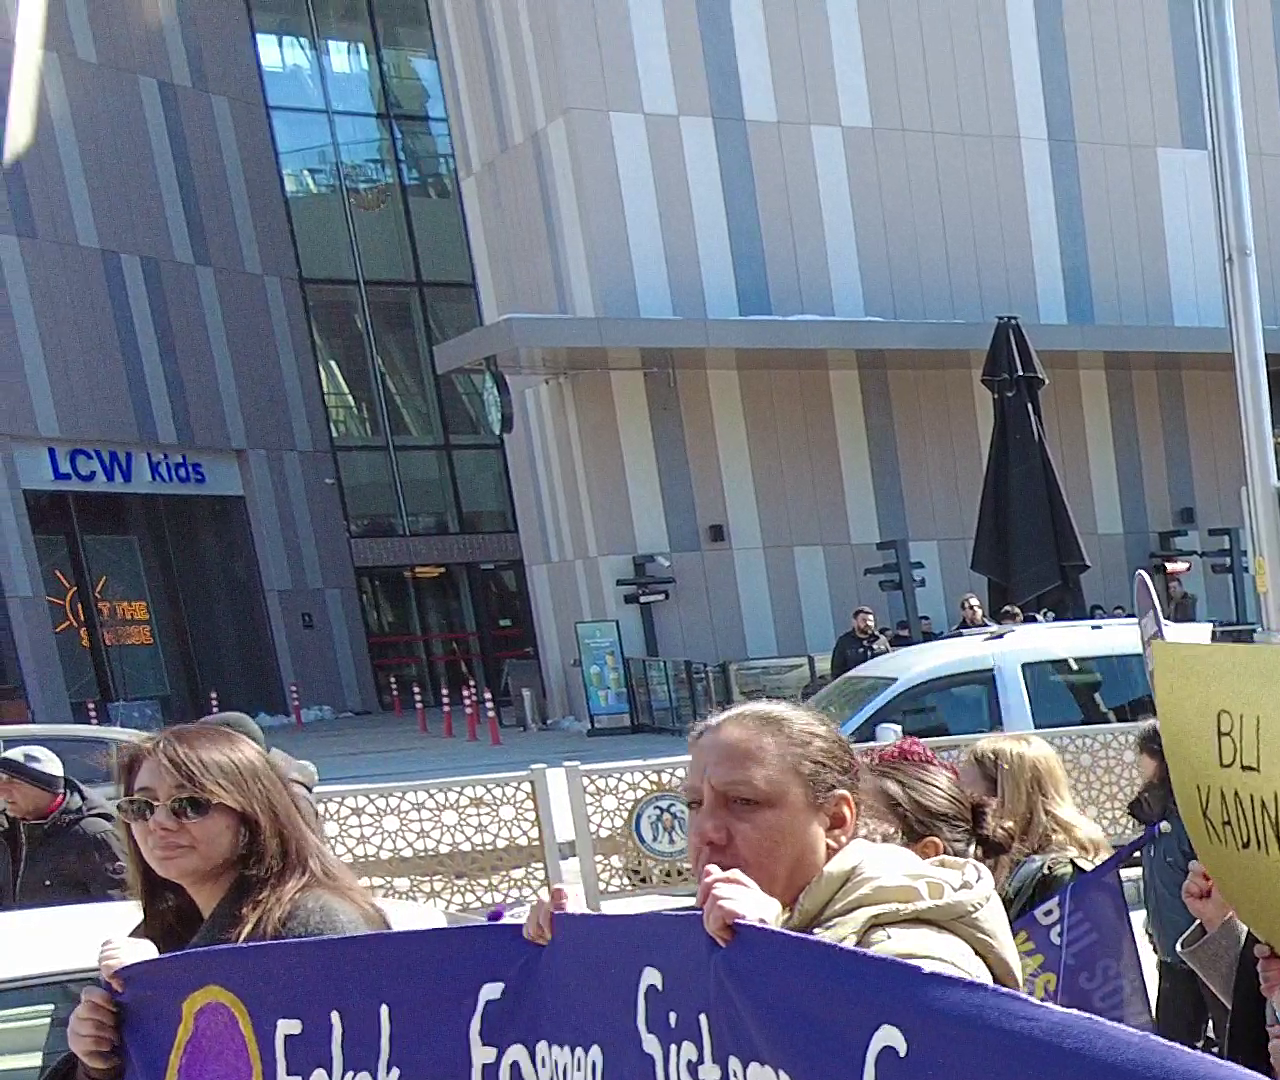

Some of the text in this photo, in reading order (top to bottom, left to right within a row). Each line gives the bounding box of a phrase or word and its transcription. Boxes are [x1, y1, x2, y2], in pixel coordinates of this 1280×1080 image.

[47, 446, 207, 484] LCW kids
[1216, 708, 1261, 774] BU
